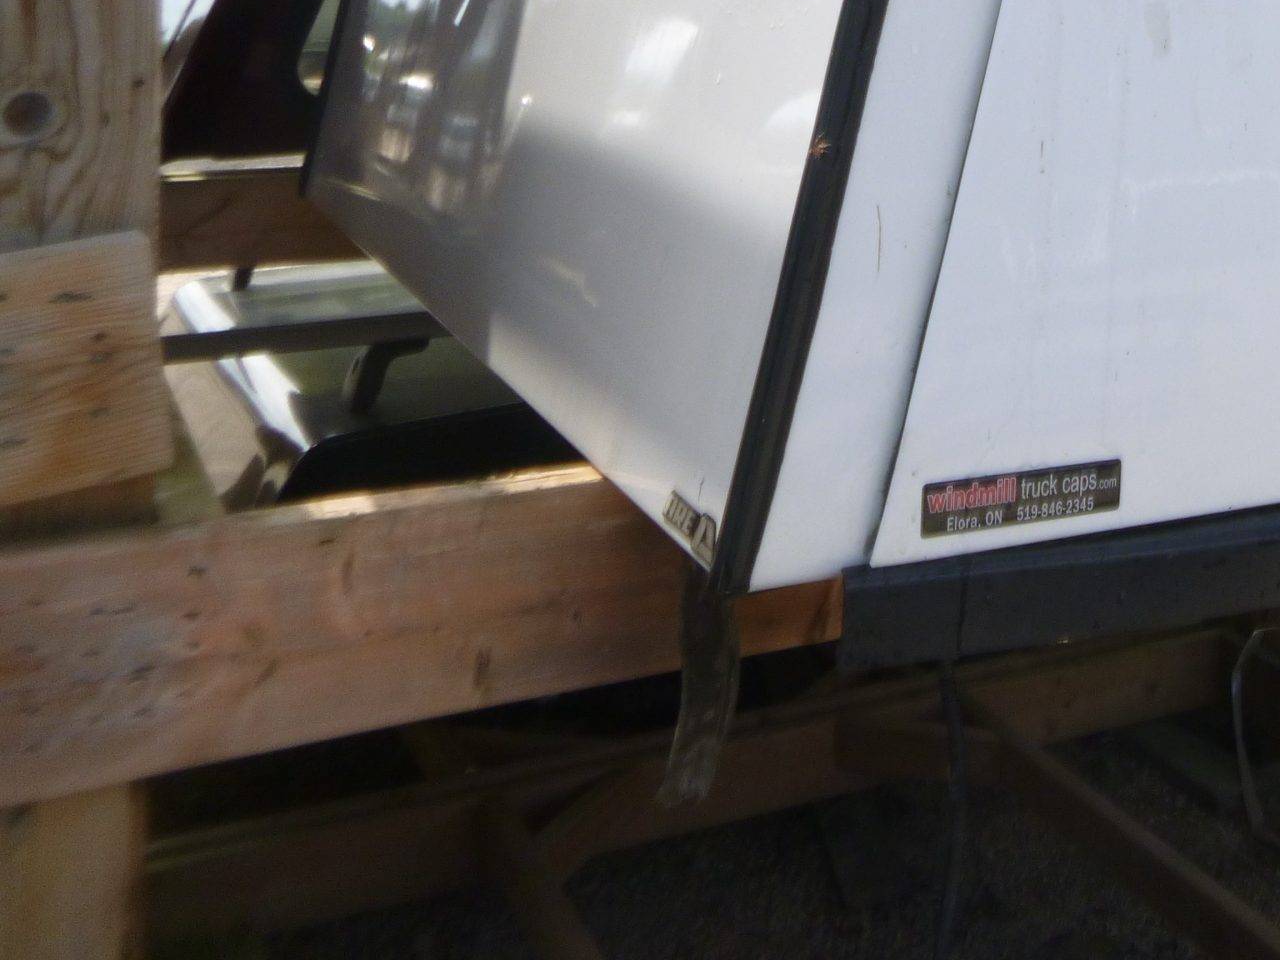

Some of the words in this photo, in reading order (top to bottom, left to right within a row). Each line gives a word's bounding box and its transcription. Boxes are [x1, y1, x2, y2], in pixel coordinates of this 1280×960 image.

[927, 475, 1018, 513] windmill
[1021, 475, 1058, 500] truck
[946, 514, 981, 531] Elora,
[985, 510, 1003, 526] ON
[1016, 496, 1094, 521] 519-846-2345
